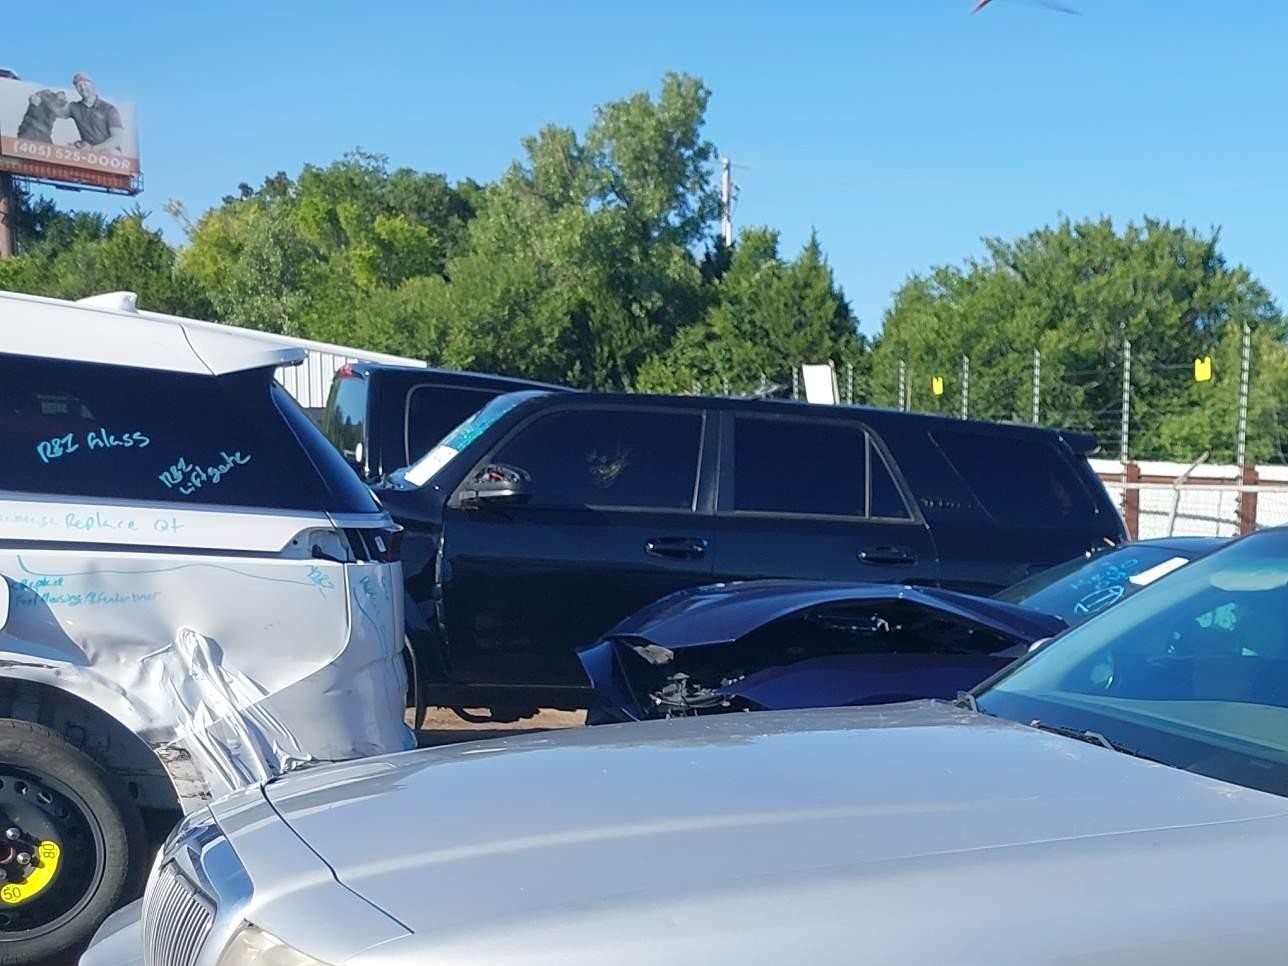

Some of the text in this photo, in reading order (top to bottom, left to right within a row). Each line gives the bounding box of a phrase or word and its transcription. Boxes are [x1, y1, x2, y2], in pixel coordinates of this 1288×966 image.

[14, 142, 131, 169] (405) 525-DOOR
[3, 887, 22, 900] 50
